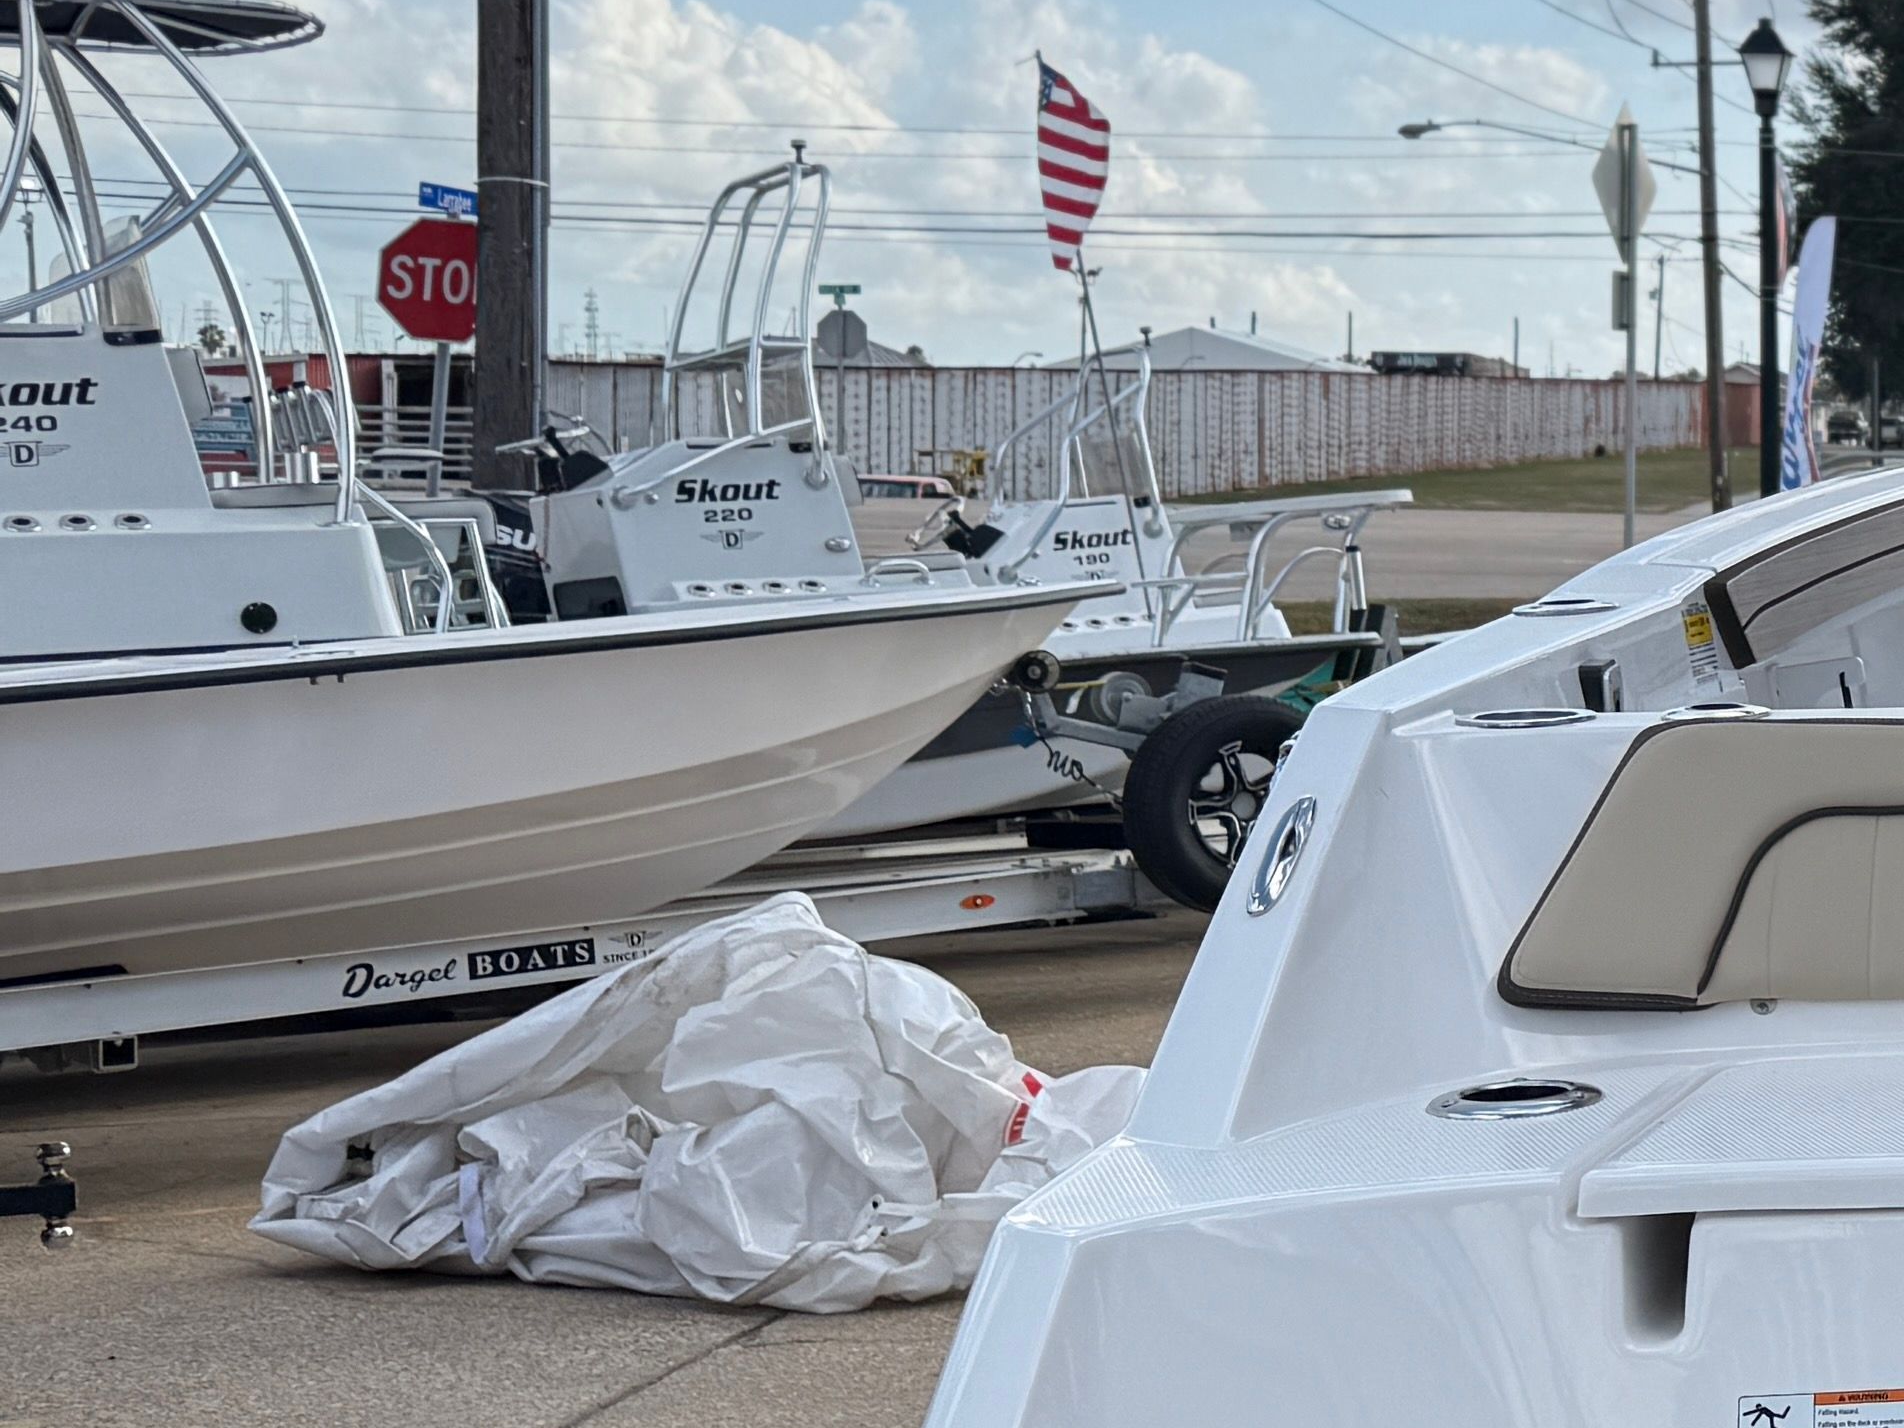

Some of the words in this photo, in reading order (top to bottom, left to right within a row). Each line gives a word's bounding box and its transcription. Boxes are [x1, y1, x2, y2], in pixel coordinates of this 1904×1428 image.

[386, 253, 477, 305] STO
[674, 479, 781, 504] Skout
[704, 507, 753, 523] 220
[1053, 529, 1133, 551] Skout
[1073, 552, 1110, 566] 190
[602, 953, 639, 964] SINCE
[342, 958, 457, 999] Dargel
[475, 942, 592, 976] BOATS
